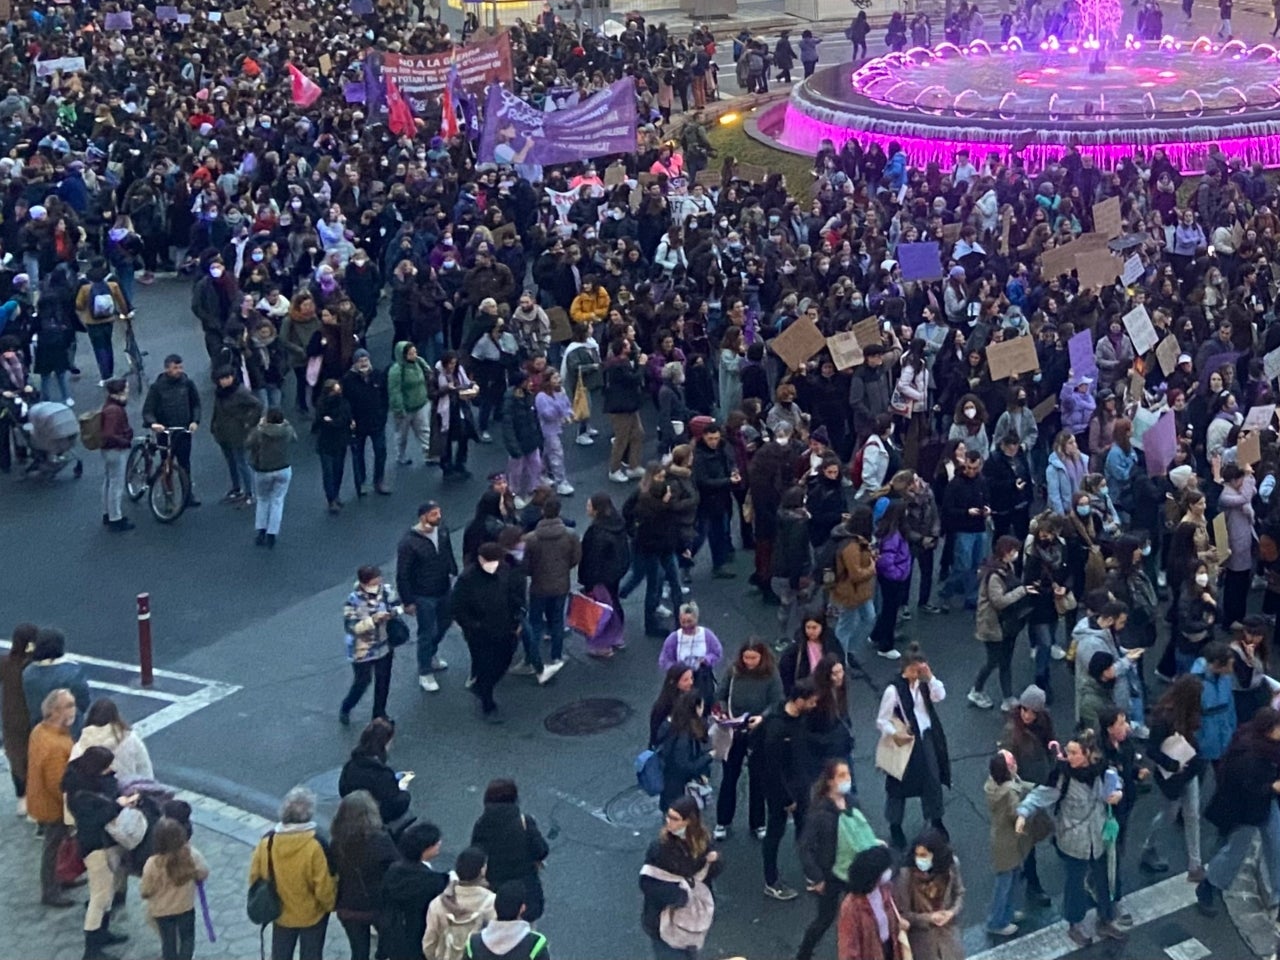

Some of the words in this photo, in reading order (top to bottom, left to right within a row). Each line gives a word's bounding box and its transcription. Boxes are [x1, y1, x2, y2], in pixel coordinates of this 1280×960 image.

[399, 58, 414, 68] NO
[416, 59, 425, 69] A
[426, 58, 441, 68] LA
